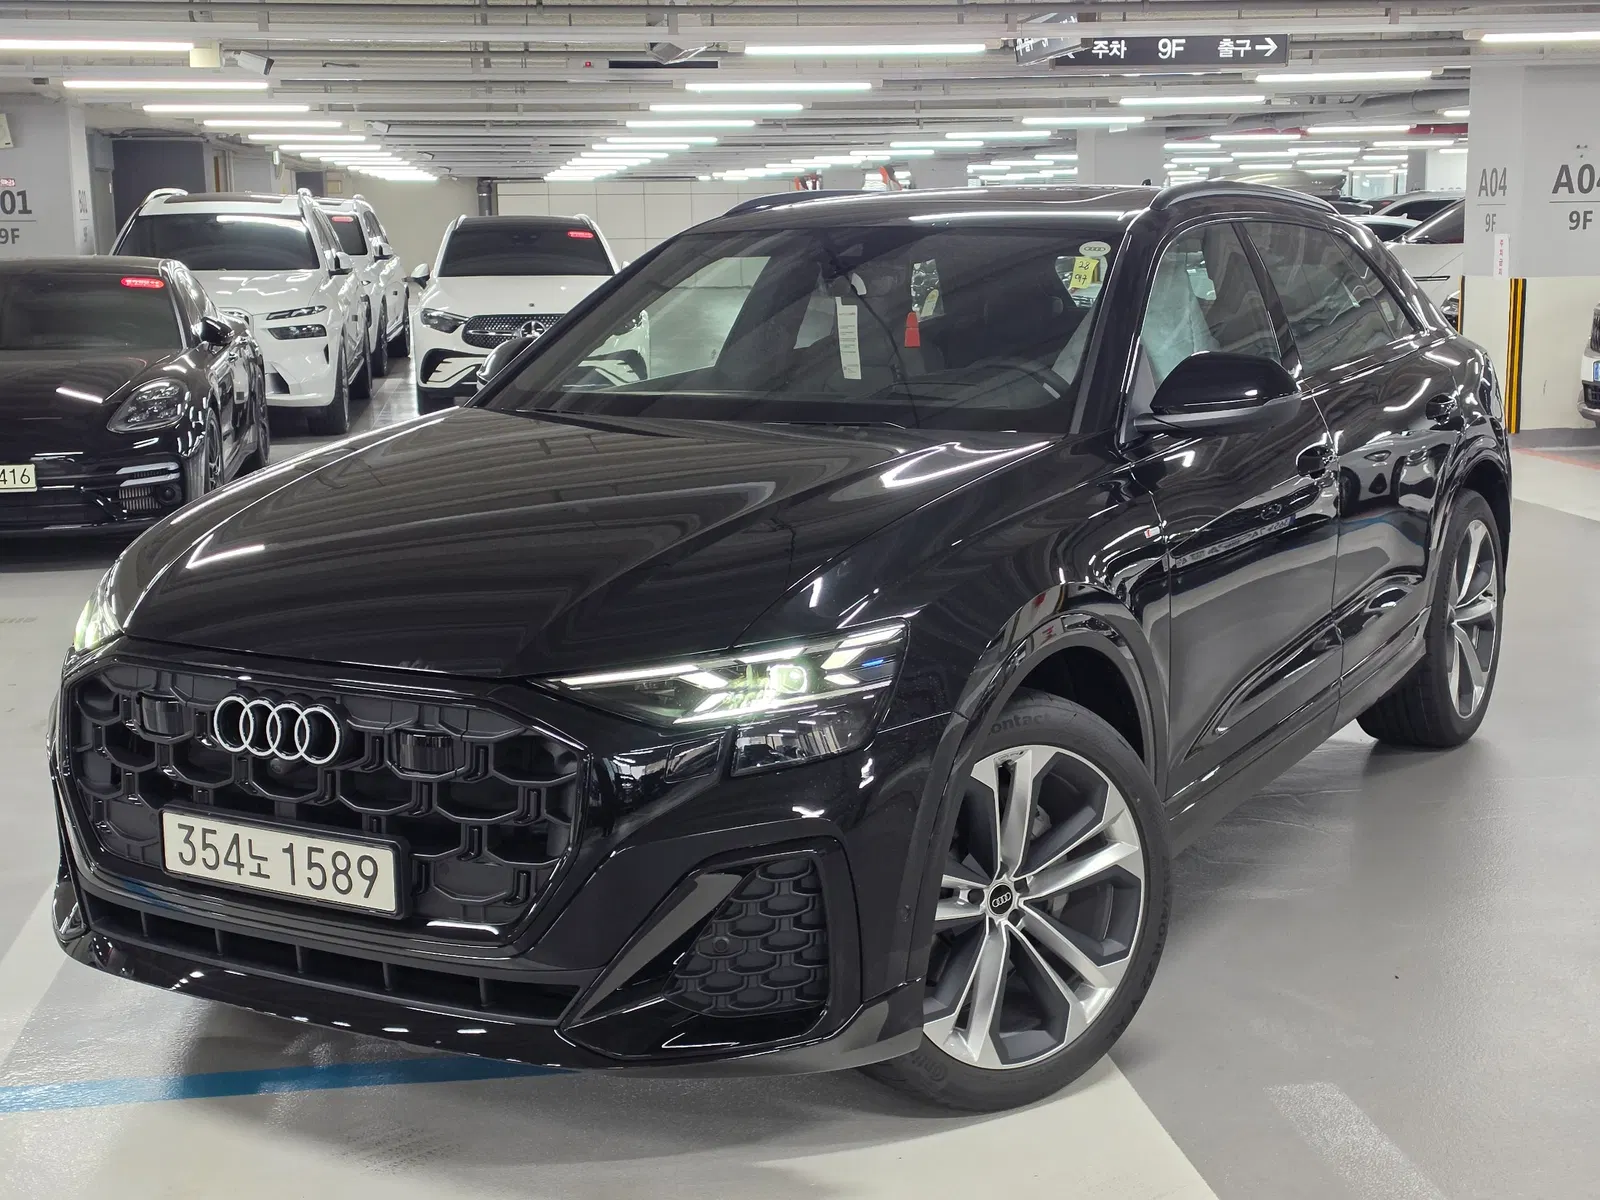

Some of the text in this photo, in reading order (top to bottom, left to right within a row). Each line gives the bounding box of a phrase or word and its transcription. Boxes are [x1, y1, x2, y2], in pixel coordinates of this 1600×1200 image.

[1091, 38, 1128, 60] 주차
[1157, 38, 1187, 60] 9F
[1217, 38, 1253, 59] 출구
[1477, 167, 1508, 198] A04
[1551, 163, 1600, 195] A0
[1485, 212, 1497, 233] 9F
[1568, 210, 1594, 231] 9F
[0, 227, 21, 245] 9F
[177, 822, 379, 899] 354노 1589
